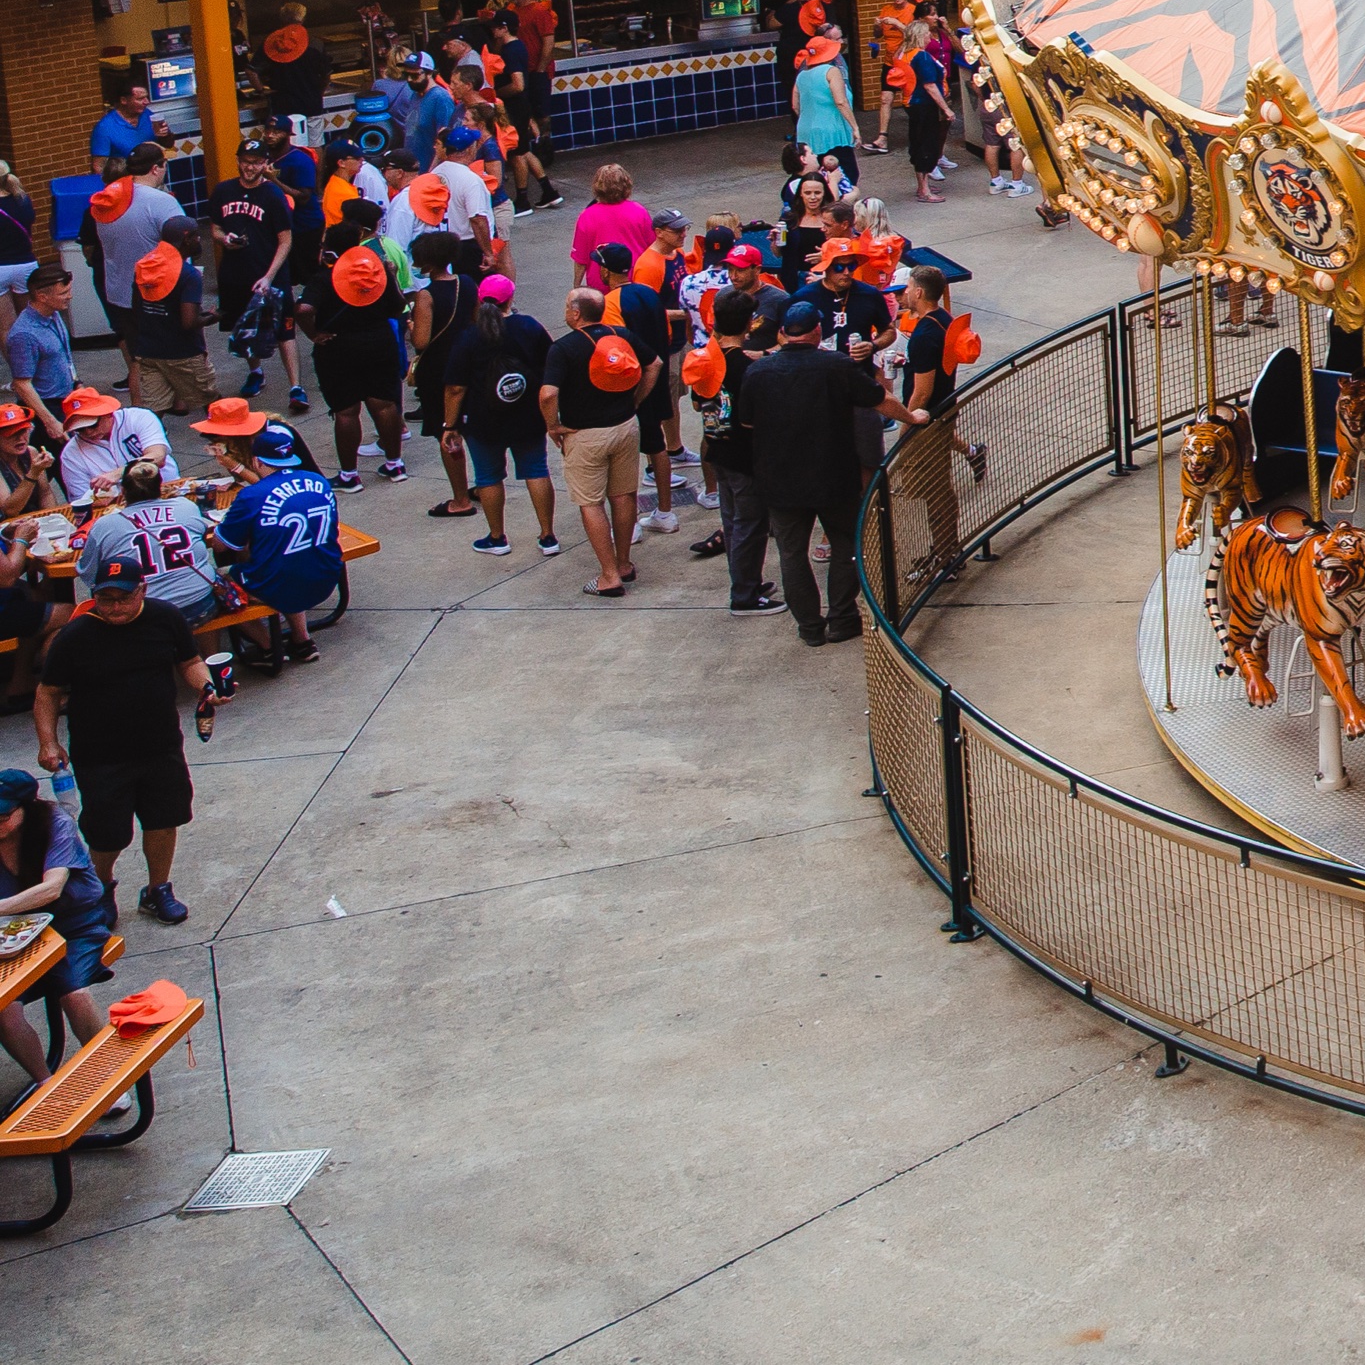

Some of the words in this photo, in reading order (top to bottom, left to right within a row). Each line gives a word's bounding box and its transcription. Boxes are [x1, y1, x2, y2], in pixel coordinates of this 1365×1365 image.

[1292, 245, 1337, 268] TIGER
[833, 310, 847, 329] D
[260, 478, 324, 527] GUERRERO
[132, 526, 196, 577] 12
[279, 505, 332, 556] 27
